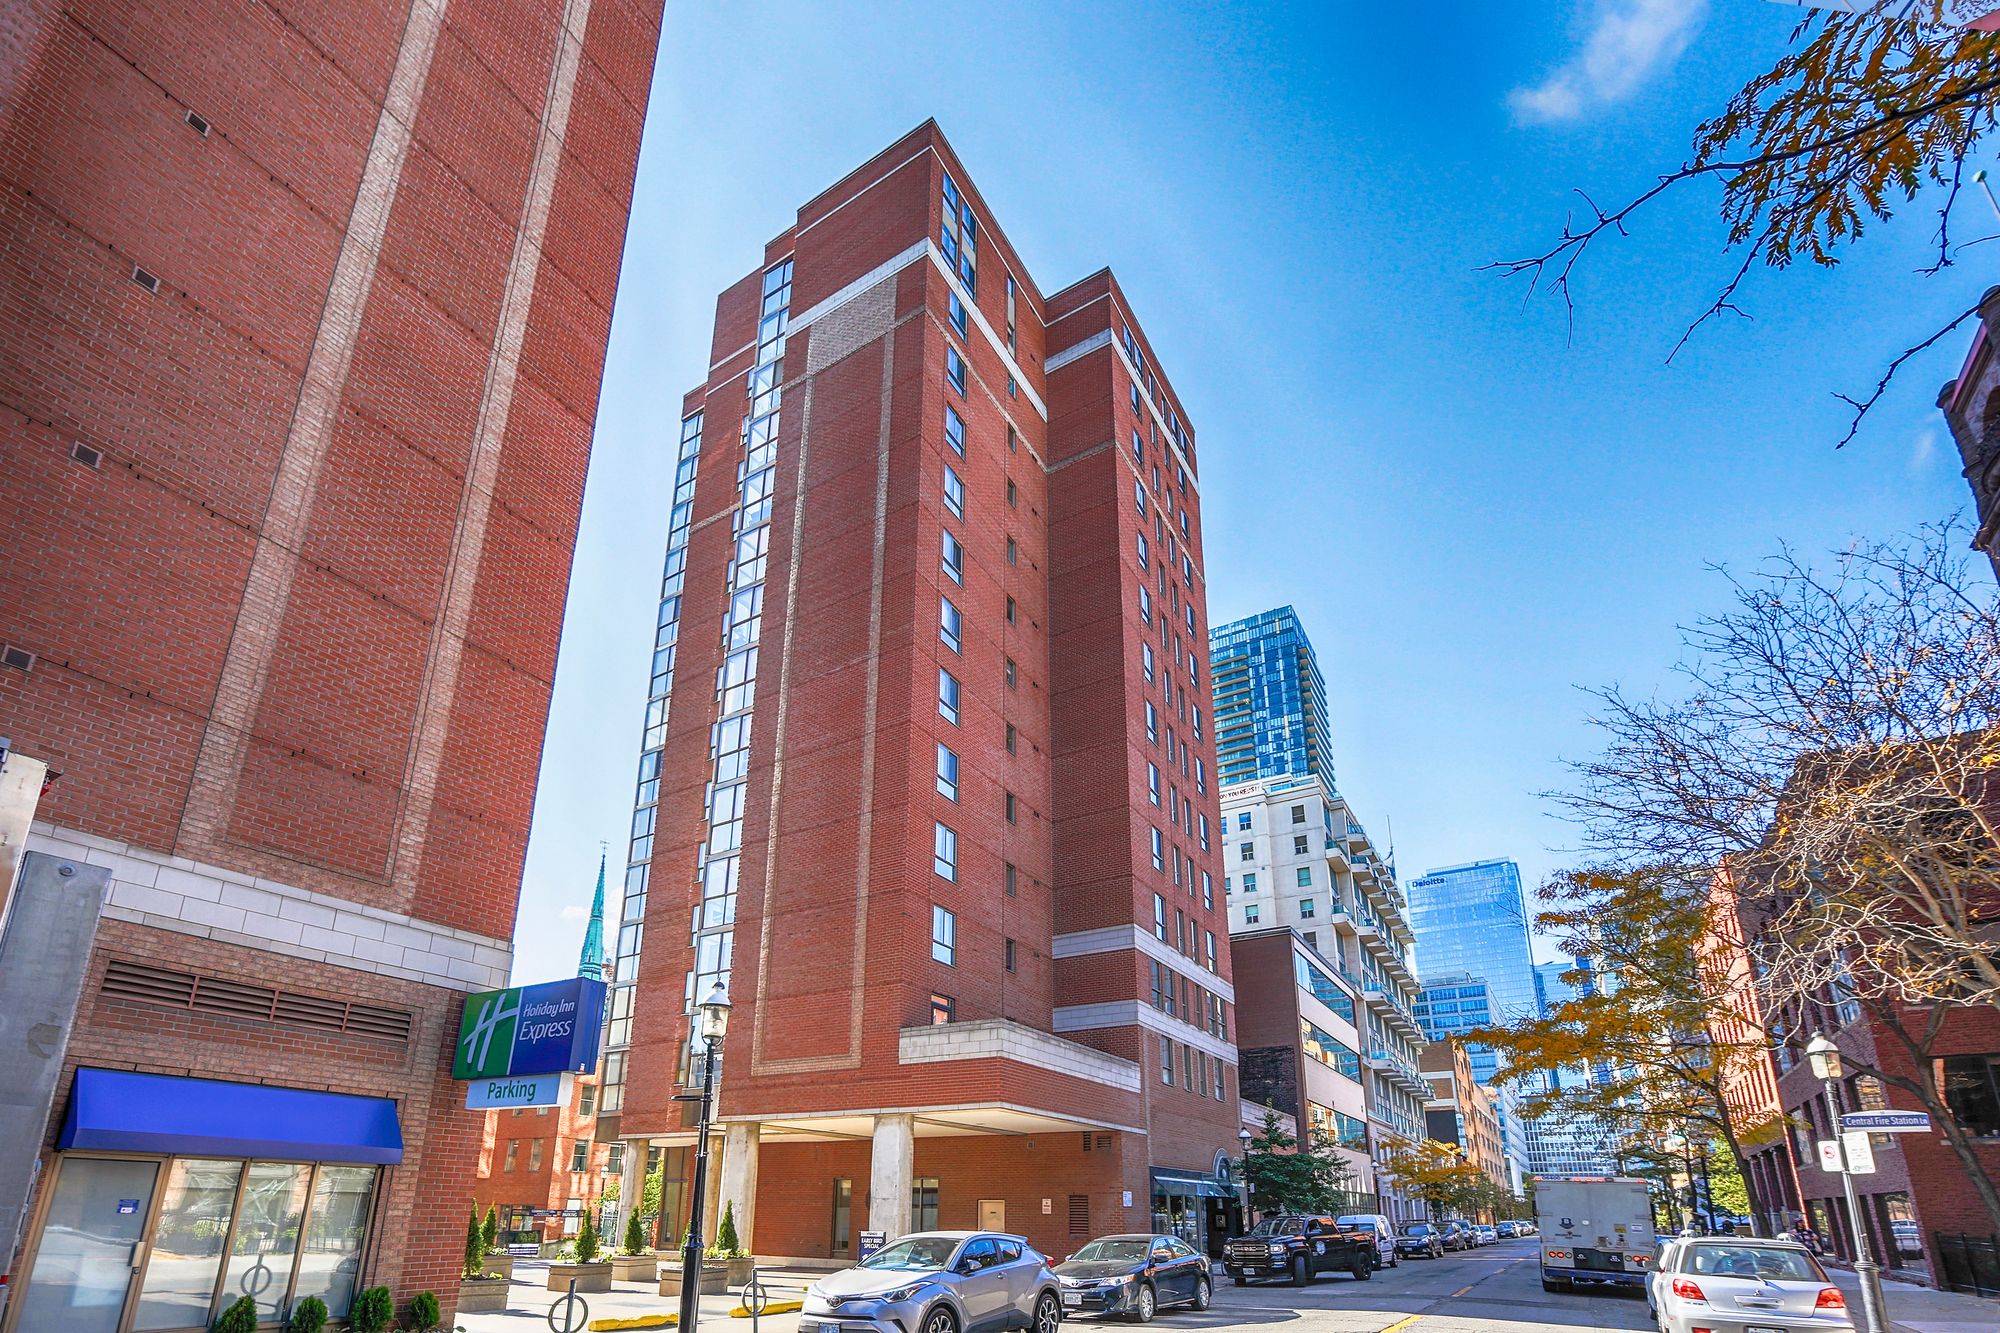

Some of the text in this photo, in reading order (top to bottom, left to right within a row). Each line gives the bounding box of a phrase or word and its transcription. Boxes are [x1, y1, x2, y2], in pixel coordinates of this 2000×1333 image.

[1412, 877, 1445, 888] Deloitte
[523, 999, 575, 1018] Holiday Inn
[519, 1019, 572, 1044] Express
[487, 1080, 537, 1101] Parking
[1846, 1117, 1874, 1126] Central
[1875, 1116, 1890, 1125] Fire
[1890, 1116, 1919, 1125] Station
